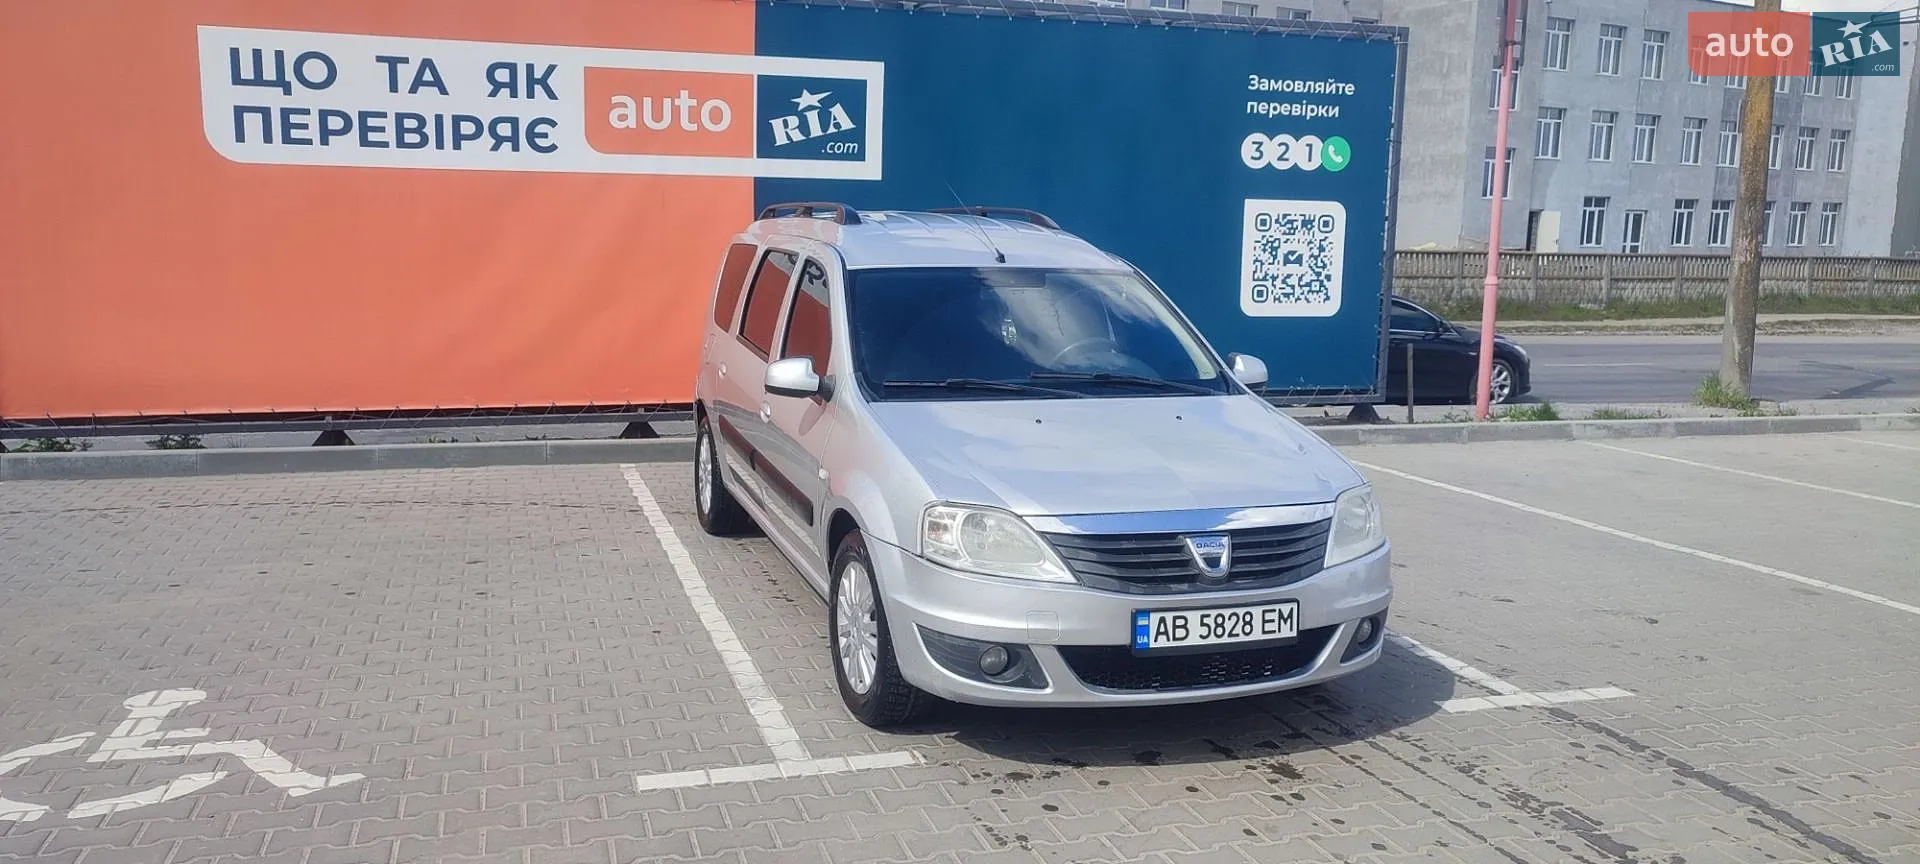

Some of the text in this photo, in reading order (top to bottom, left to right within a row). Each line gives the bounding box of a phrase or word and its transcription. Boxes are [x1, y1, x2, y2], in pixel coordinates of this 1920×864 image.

[229, 47, 559, 101] ЩО ТА ЯК
[1247, 74, 1356, 96] Замовляйте
[233, 105, 559, 154] ПЕРЕВІРЯЄ
[608, 89, 732, 133] auto
[768, 102, 857, 147] RIA
[1246, 100, 1340, 120] перевірки
[1137, 635, 1149, 644] UA
[1153, 607, 1294, 643] AB 5828 EM
